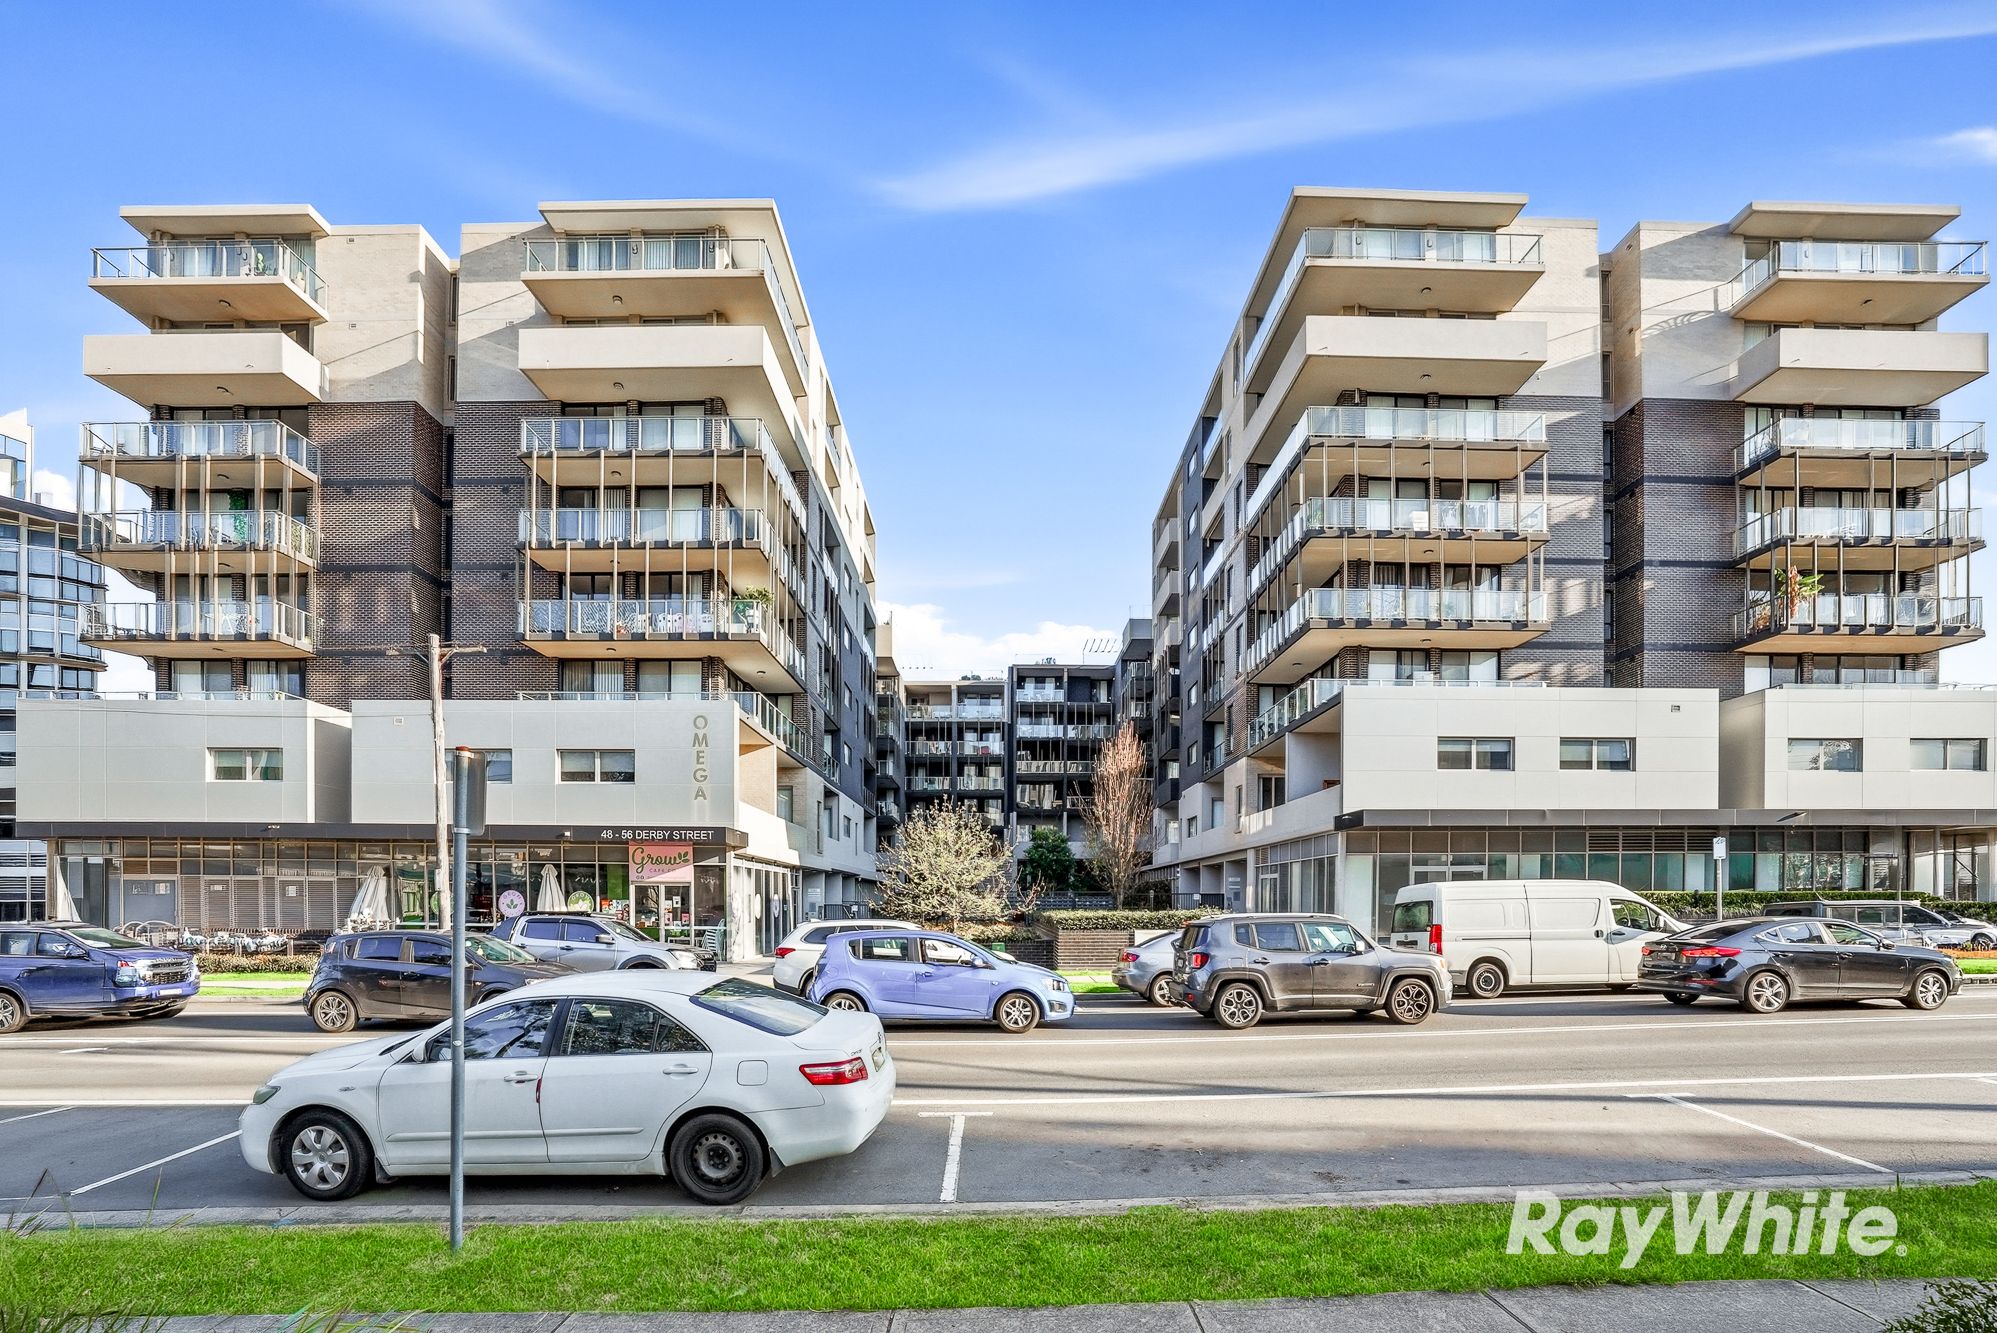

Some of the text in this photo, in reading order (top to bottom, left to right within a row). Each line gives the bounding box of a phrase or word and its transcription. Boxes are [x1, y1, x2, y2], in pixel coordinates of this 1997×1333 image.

[692, 714, 709, 801] OMEGA
[601, 829, 613, 839] 48
[621, 829, 633, 839] 56
[635, 830, 670, 840] DERBY
[672, 830, 714, 840] STREET
[631, 846, 681, 874] Grow
